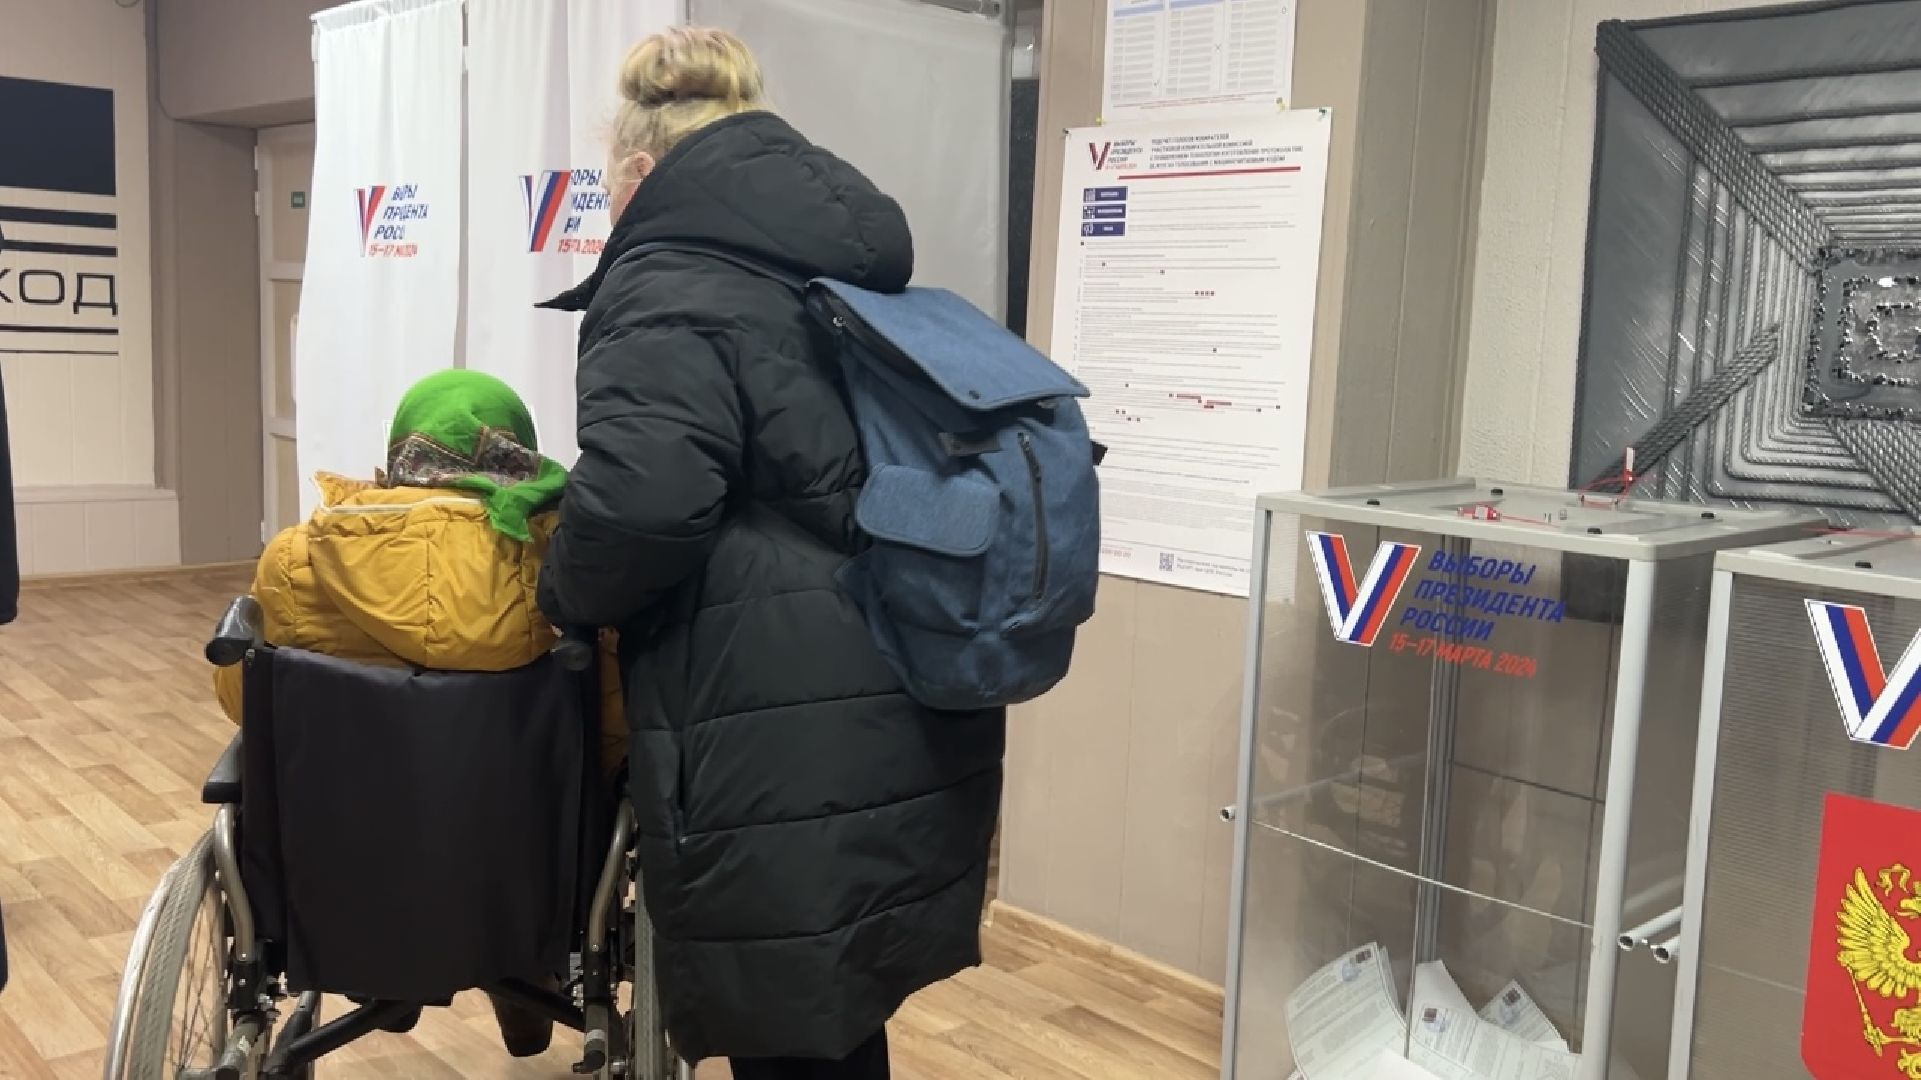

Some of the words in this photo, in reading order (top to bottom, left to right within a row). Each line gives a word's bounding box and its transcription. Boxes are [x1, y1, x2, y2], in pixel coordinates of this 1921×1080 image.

[1428, 550, 1536, 585] ВЫБОРЫ
[1414, 580, 1567, 623] ПРЕЗИДЕНТА
[1400, 607, 1495, 641] РОССИИ
[1436, 642, 1492, 669] МАРТА
[1494, 653, 1538, 679] 2024
